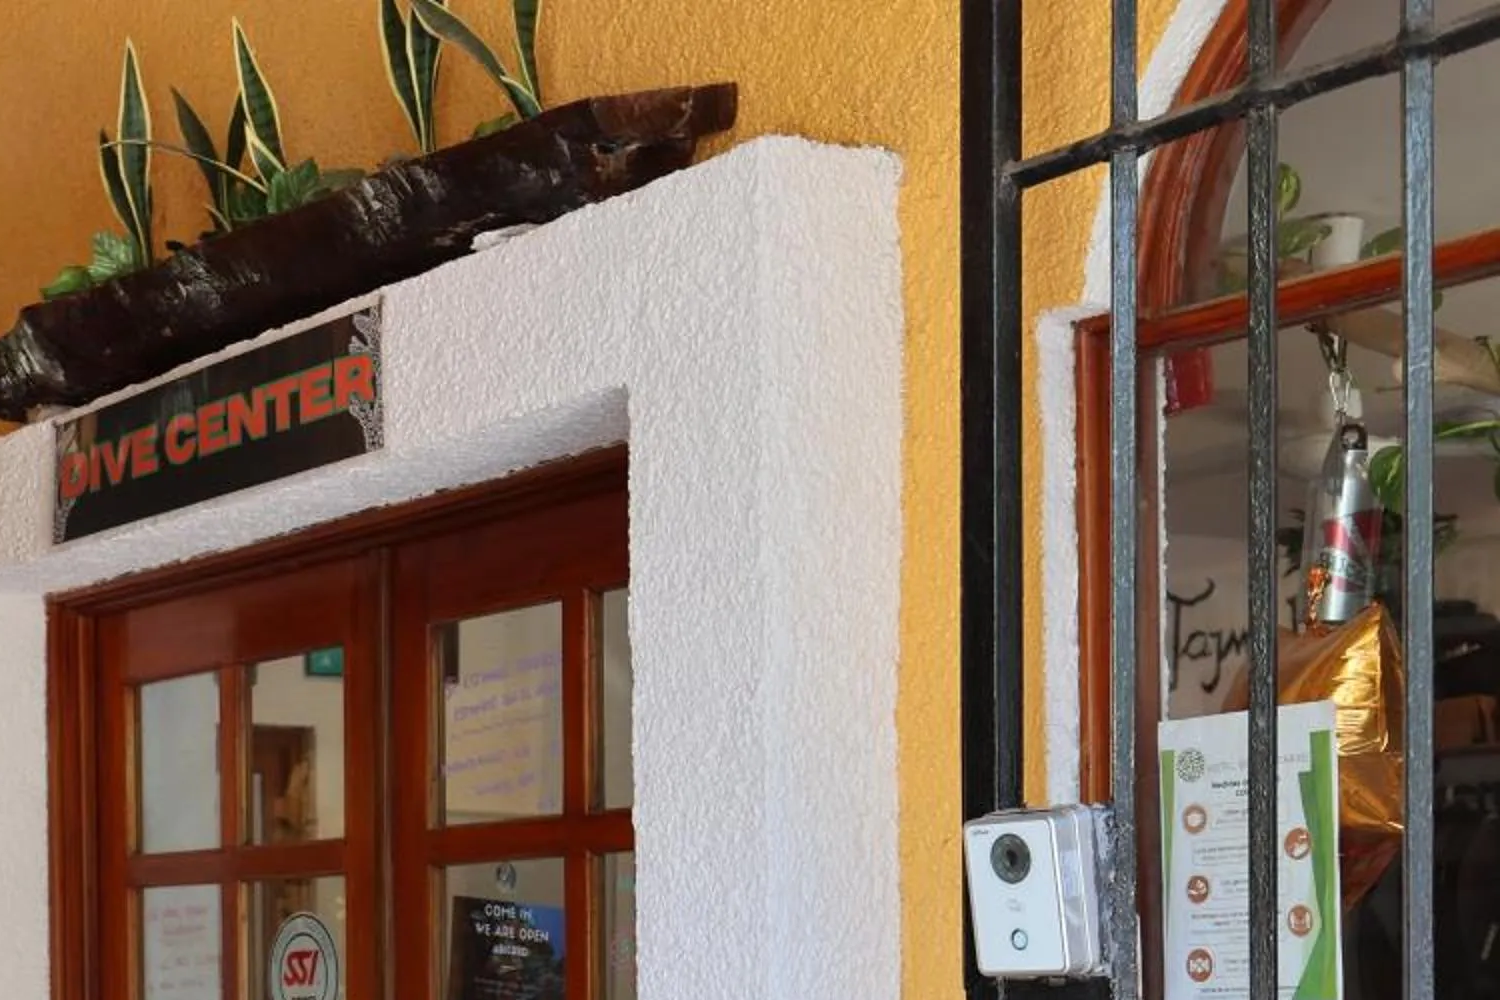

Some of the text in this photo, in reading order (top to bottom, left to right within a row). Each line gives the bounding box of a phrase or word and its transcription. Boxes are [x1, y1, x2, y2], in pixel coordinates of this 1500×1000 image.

[60, 353, 375, 499] DIVE CENTER
[484, 904, 516, 920] COME
[475, 923, 549, 943] WE ARE OPEN
